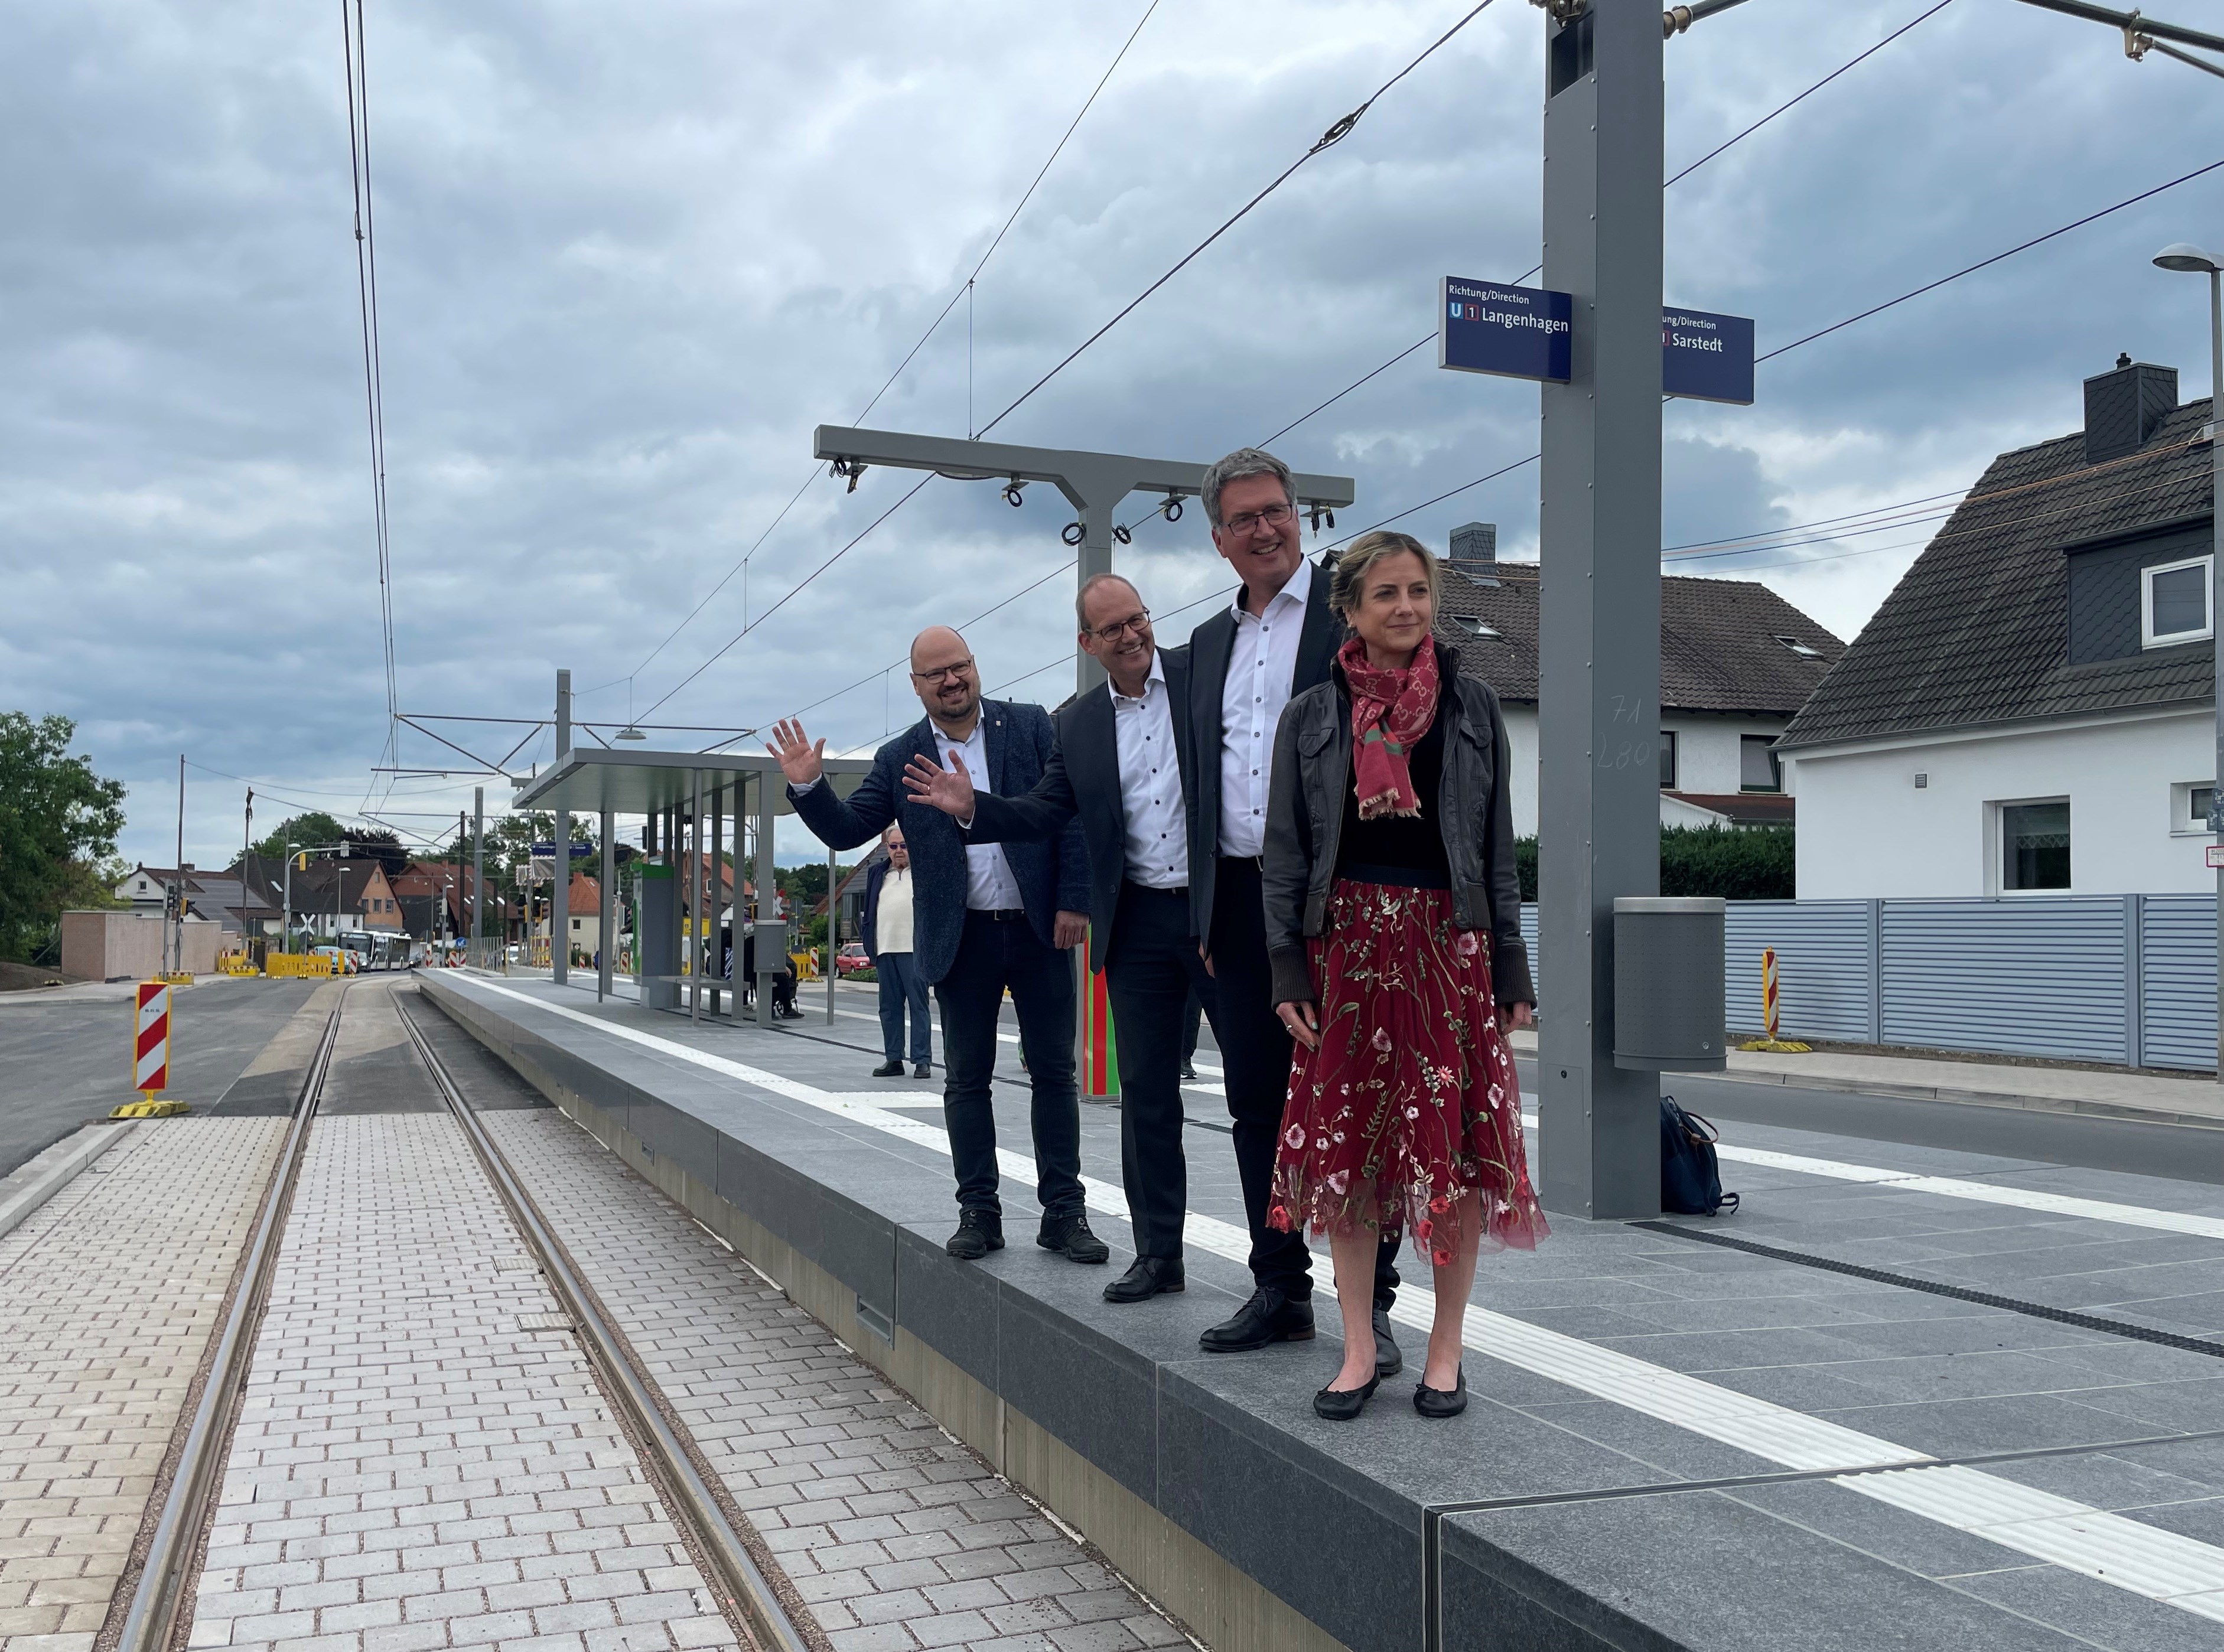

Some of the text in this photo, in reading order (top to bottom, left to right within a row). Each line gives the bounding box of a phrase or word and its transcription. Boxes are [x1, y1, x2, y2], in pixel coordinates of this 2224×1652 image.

[1449, 285, 1529, 305] Richtung/Direction
[1451, 302, 1568, 334] U 1 Langenhagen
[1672, 333, 1722, 353] Sarstedt
[1611, 695, 1641, 724] 71
